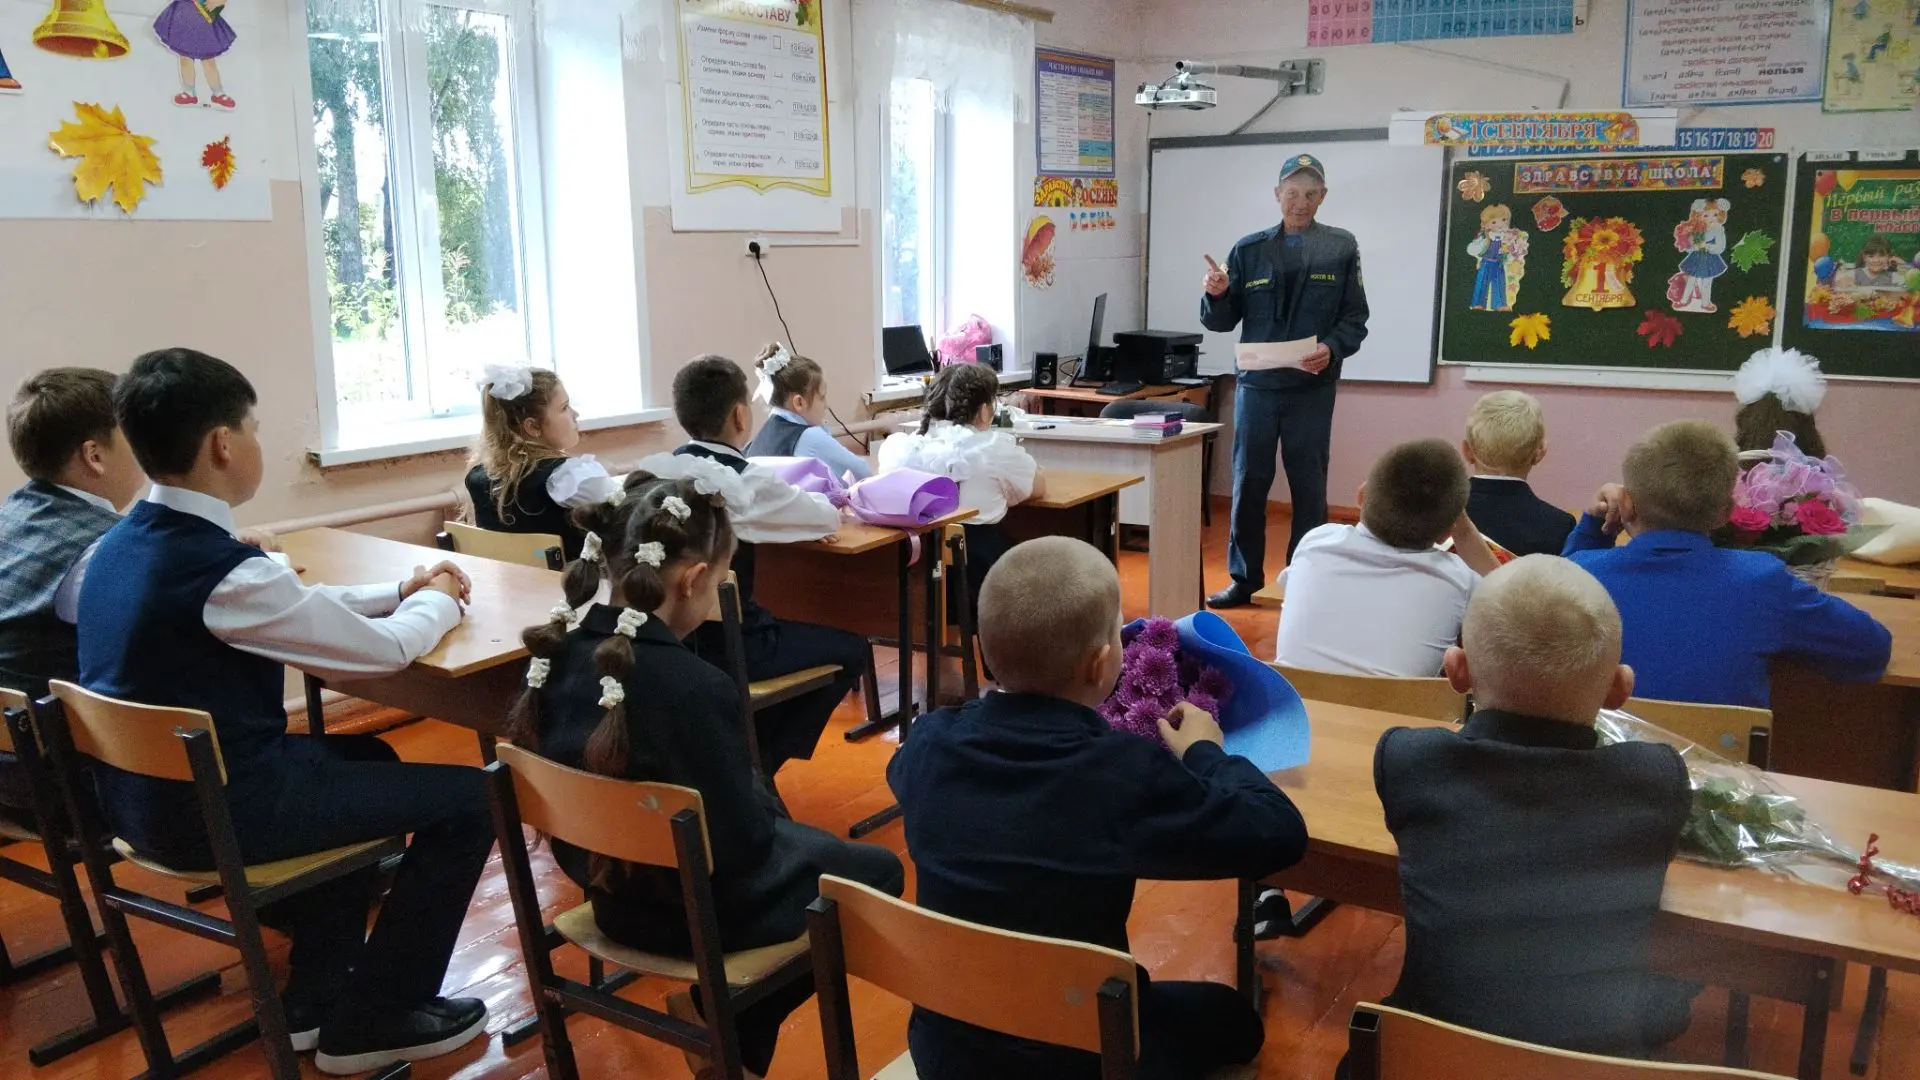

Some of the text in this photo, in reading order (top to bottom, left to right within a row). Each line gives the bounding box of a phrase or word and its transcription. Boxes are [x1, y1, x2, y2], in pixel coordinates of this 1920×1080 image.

[1470, 122, 1598, 140] 1 СЕНТЯБРЯ
[1679, 132, 1693, 147] 15
[1694, 131, 1709, 147] 16
[1711, 131, 1725, 147] 17
[1727, 131, 1741, 147] 18
[1743, 131, 1757, 147] 19
[1758, 131, 1773, 147] 20
[1648, 166, 1718, 180] ШКОЛА!
[1826, 186, 1885, 213] Первый
[1590, 262, 1610, 294] 1
[1575, 293, 1624, 303] СЕНТЯБРЯ
